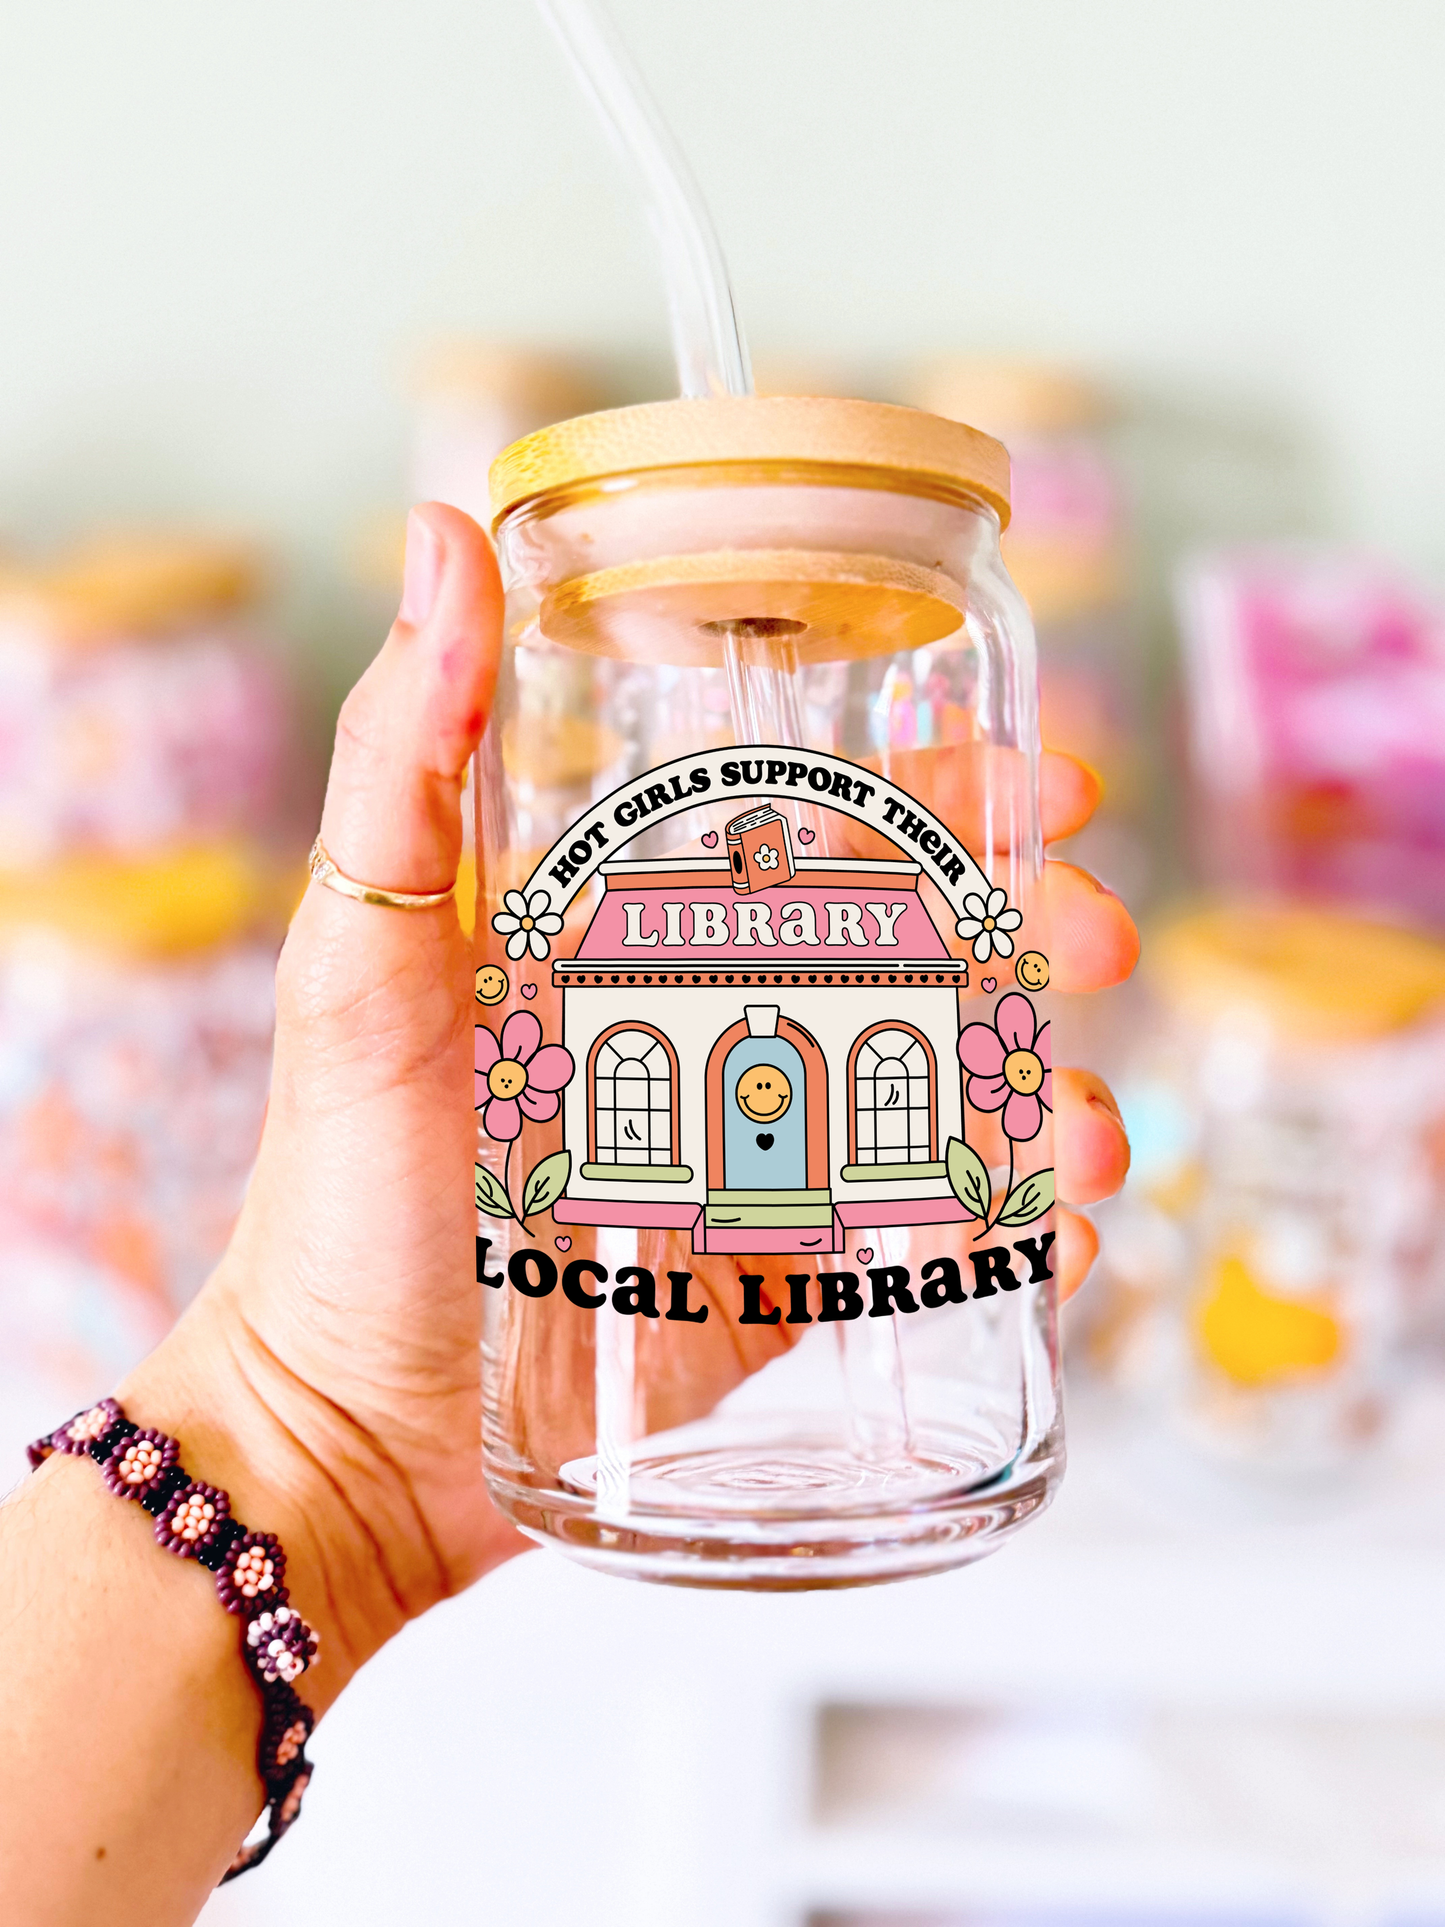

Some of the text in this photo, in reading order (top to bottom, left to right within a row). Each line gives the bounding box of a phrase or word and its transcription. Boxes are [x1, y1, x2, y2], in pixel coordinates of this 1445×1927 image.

[549, 822, 609, 889] HOT
[614, 768, 711, 827] GIRLS
[721, 760, 875, 808] SUPPORT
